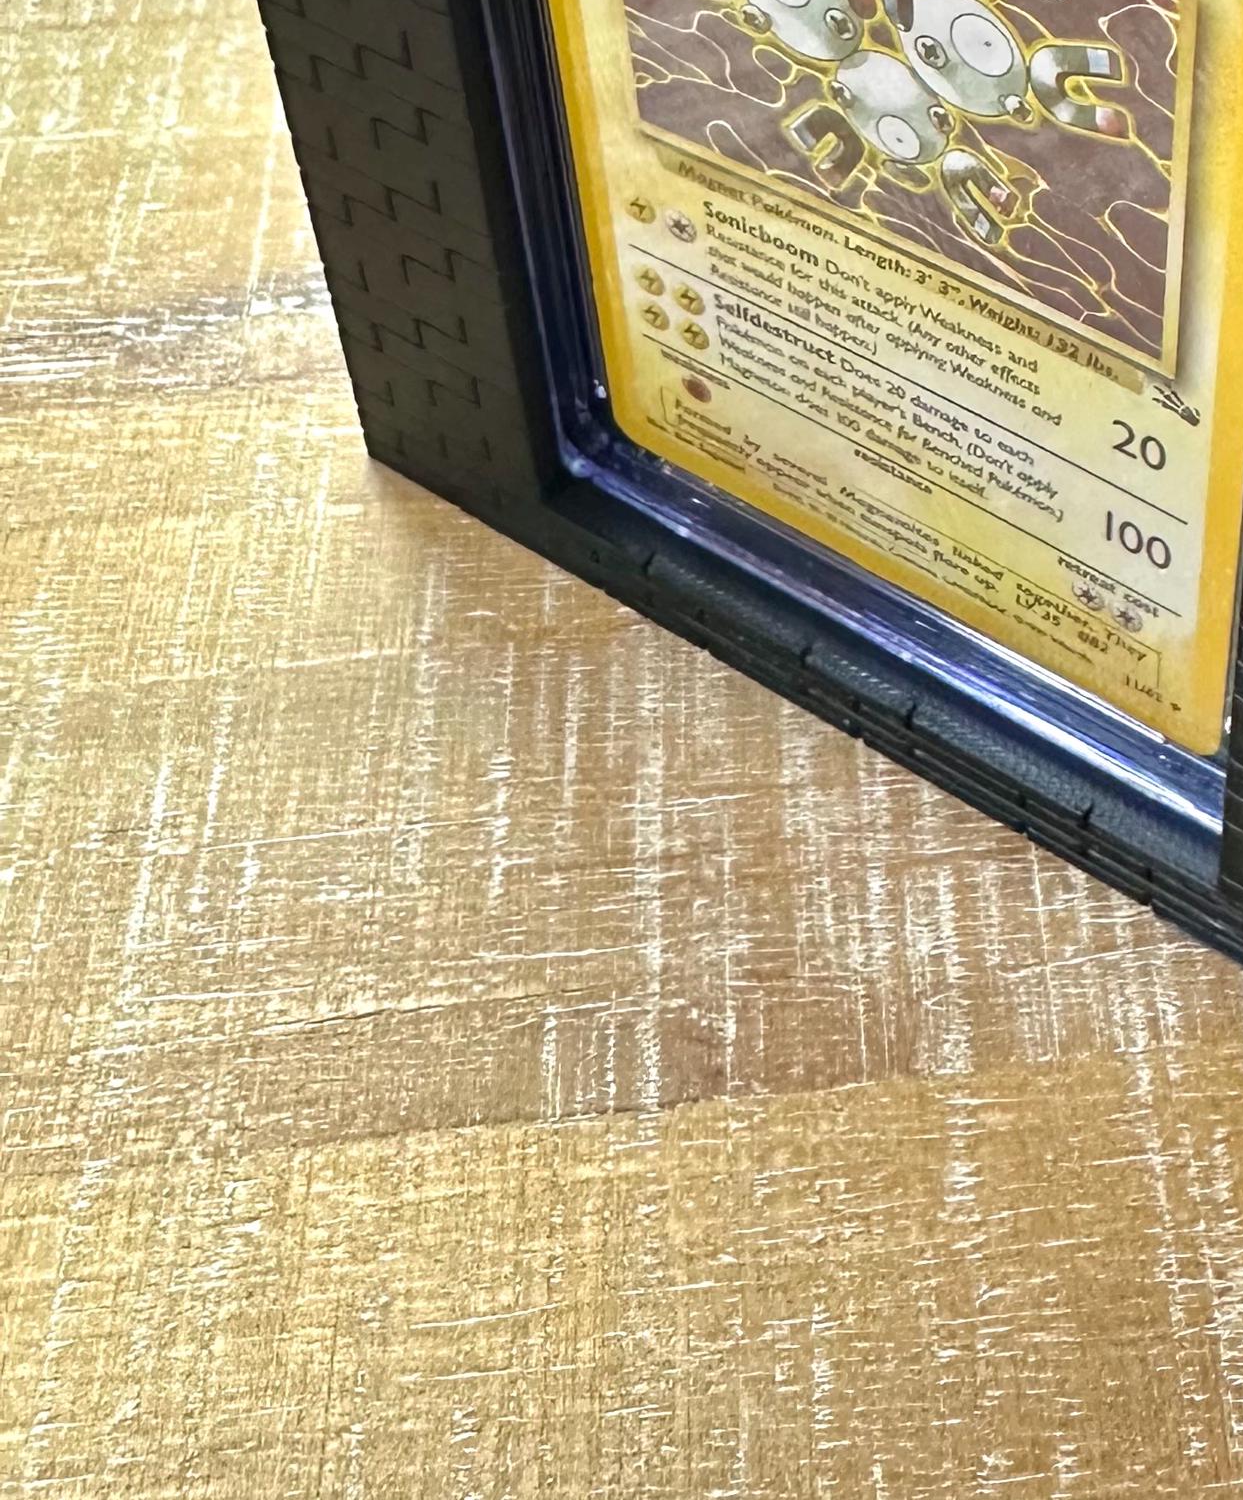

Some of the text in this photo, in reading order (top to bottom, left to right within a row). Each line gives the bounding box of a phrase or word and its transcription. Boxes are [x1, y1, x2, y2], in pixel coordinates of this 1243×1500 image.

[845, 236, 910, 277] Length:
[703, 201, 818, 266] Sonicboom
[826, 259, 870, 292] Don't
[1009, 351, 1037, 373] and
[714, 294, 836, 364] Selfdestruct
[886, 381, 905, 399] 20
[1032, 406, 1061, 426] and
[1113, 420, 1165, 470] 20
[1106, 511, 1171, 569] 100
